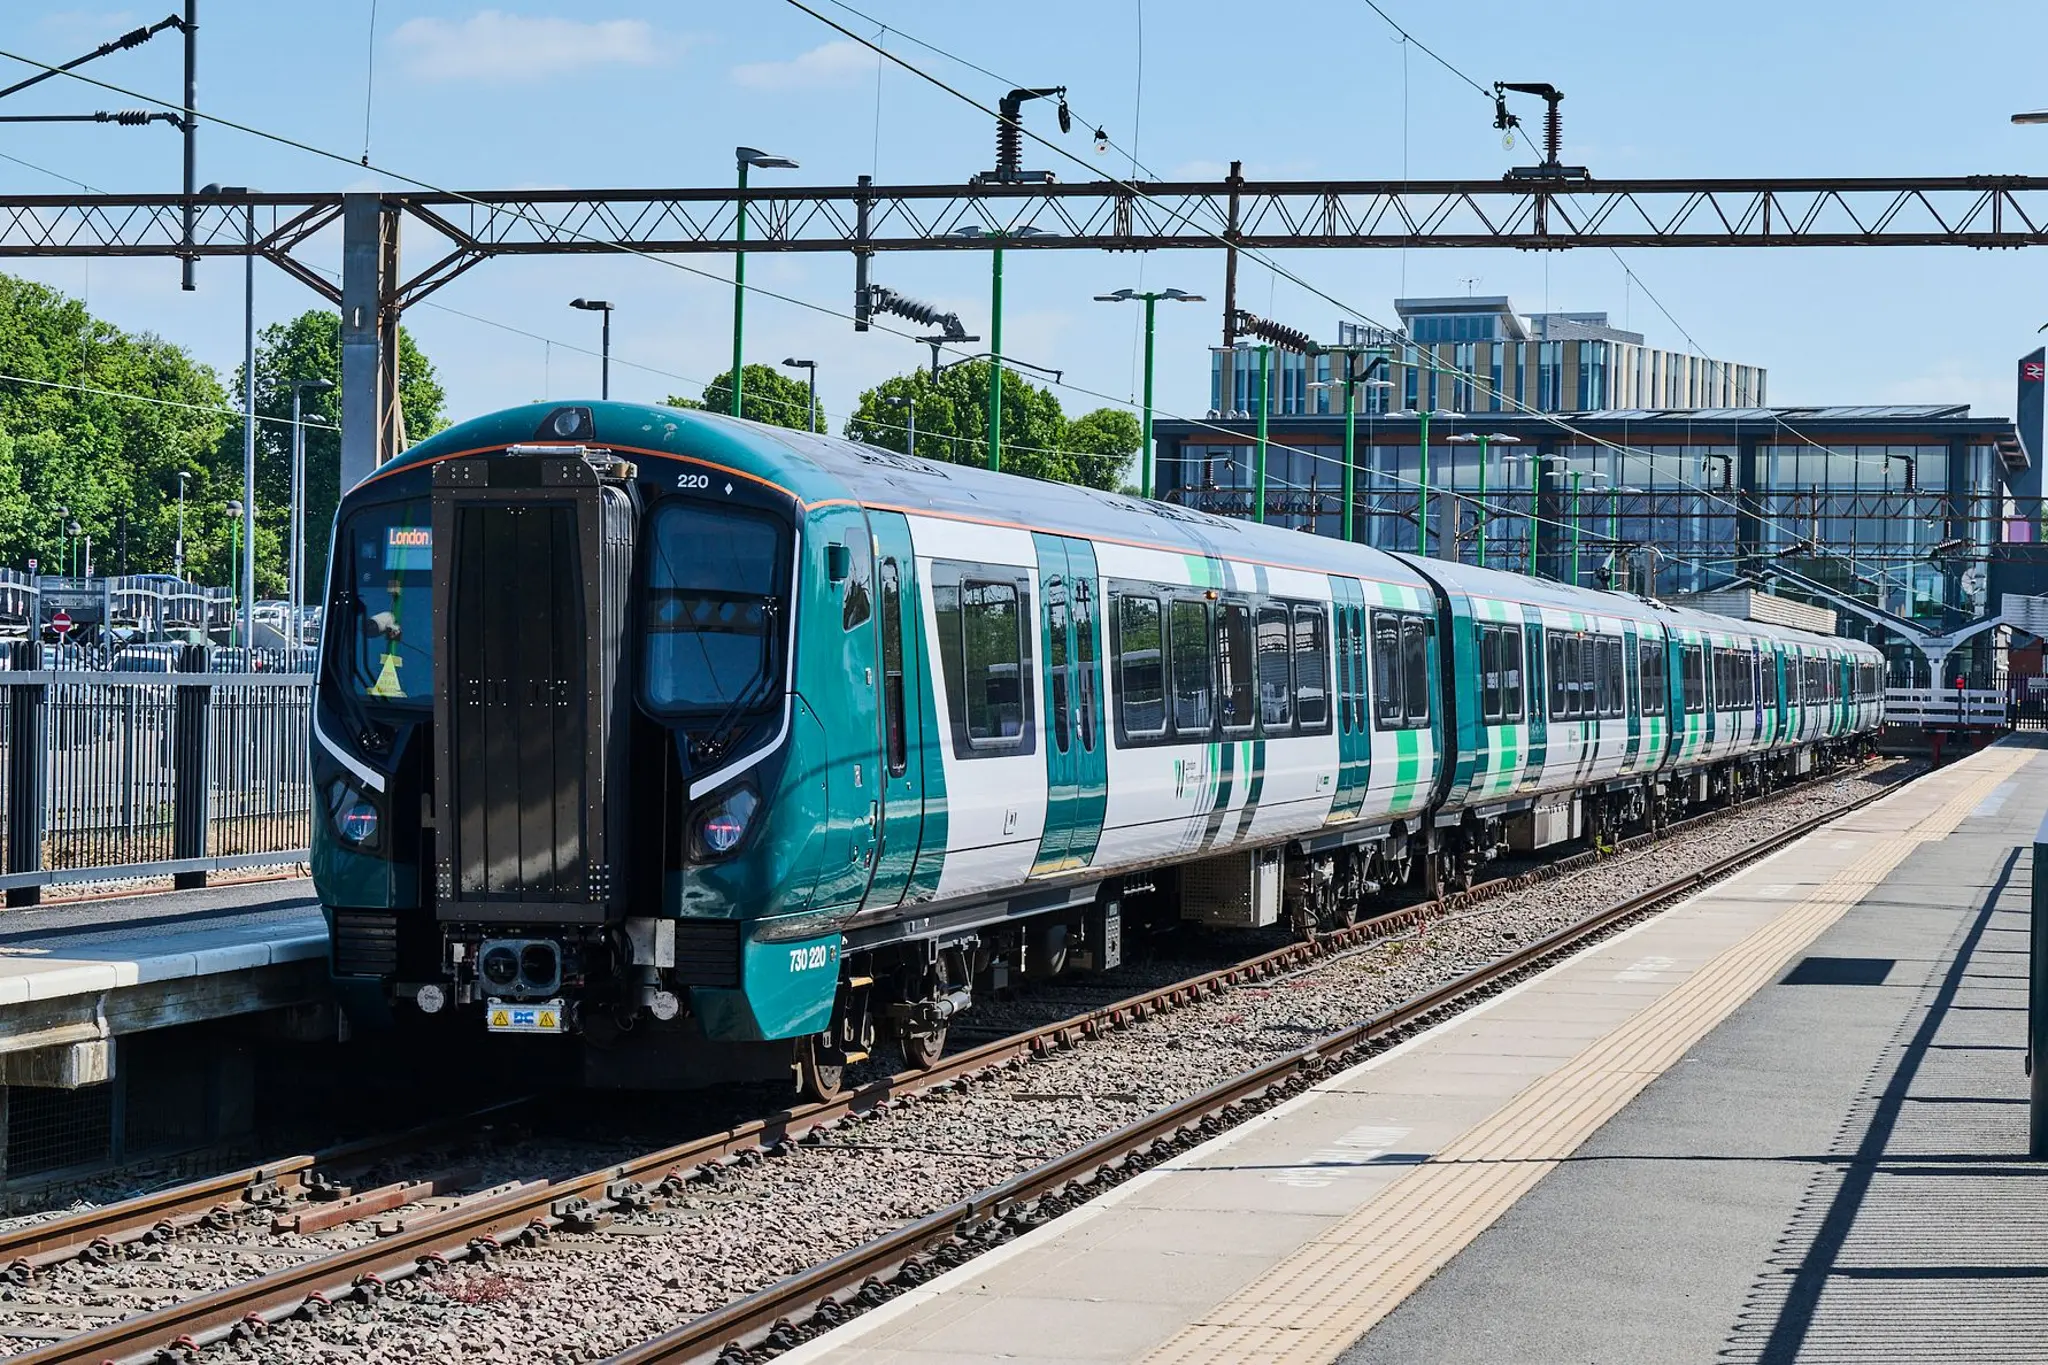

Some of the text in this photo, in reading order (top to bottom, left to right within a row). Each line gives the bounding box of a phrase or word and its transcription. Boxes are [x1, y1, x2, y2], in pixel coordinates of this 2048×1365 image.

[677, 474, 709, 489] 220
[389, 528, 429, 545] London
[790, 945, 827, 972] 730 220
